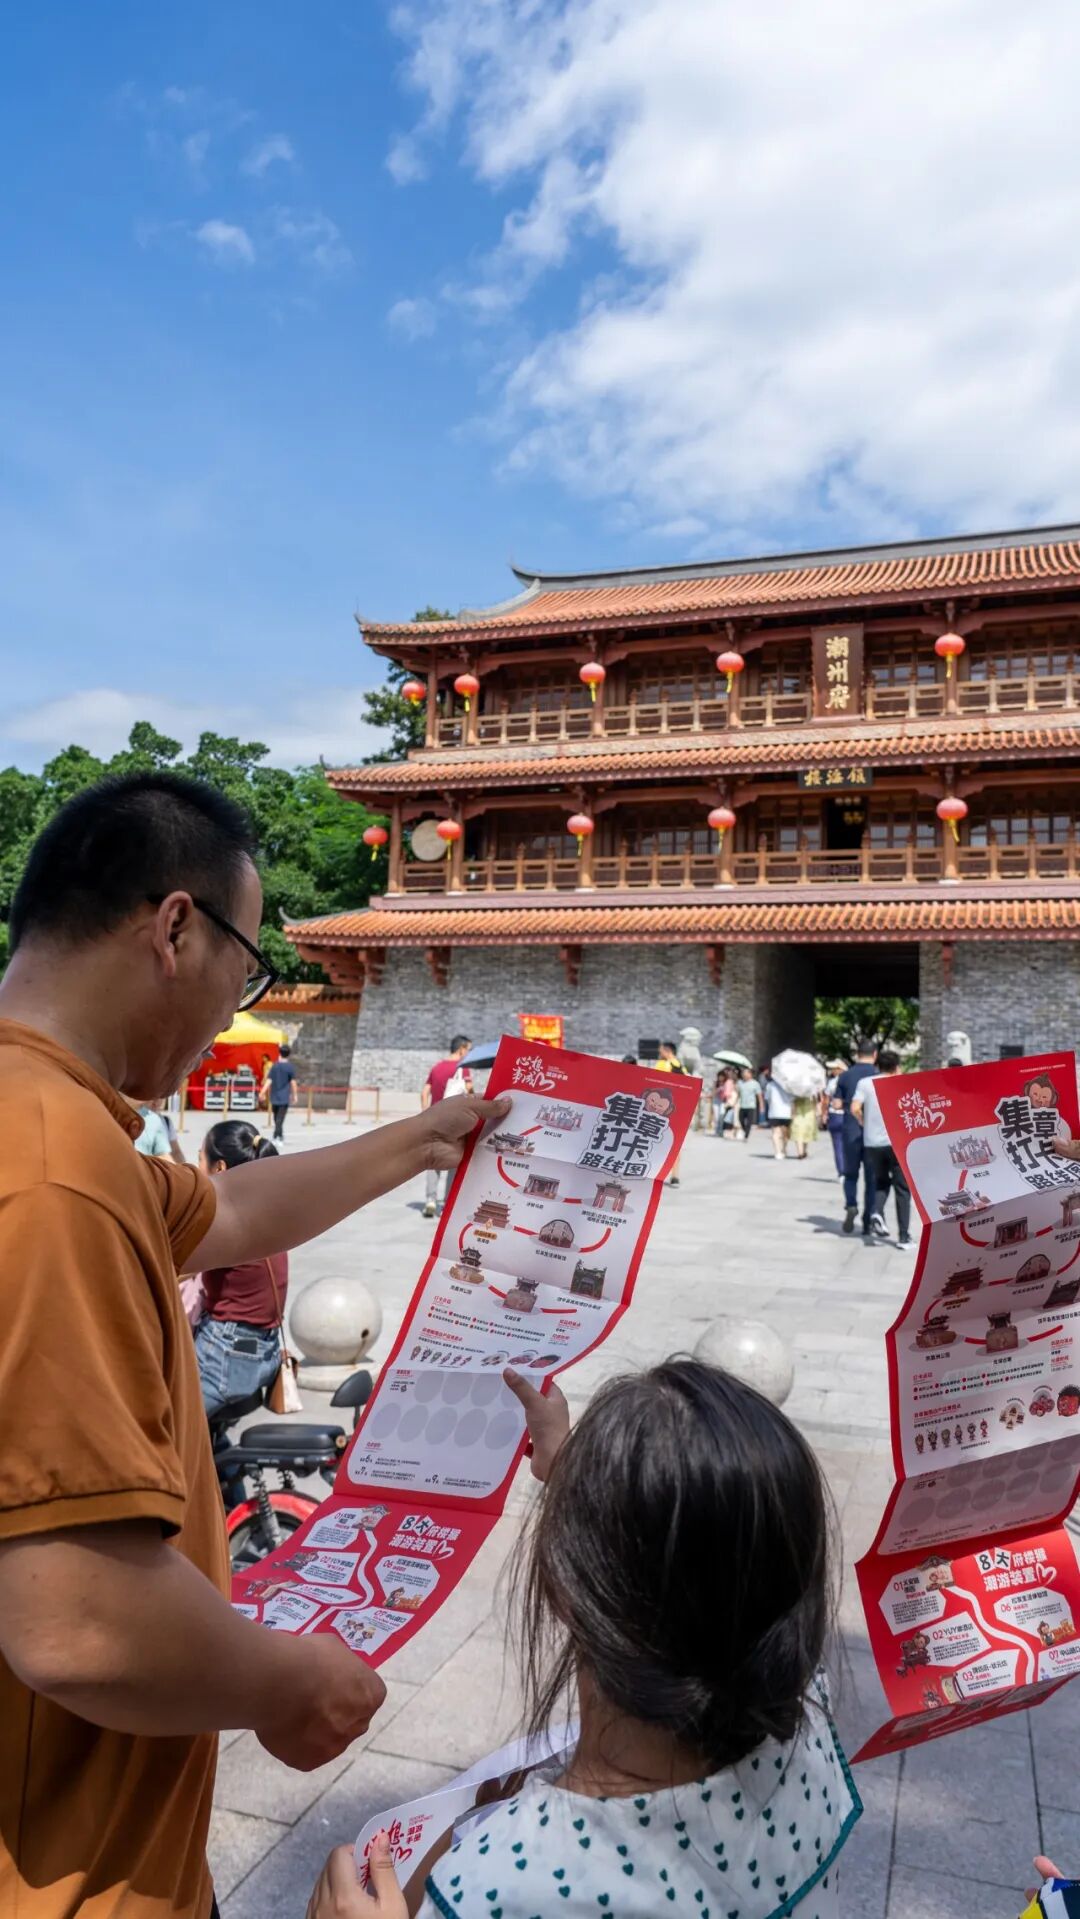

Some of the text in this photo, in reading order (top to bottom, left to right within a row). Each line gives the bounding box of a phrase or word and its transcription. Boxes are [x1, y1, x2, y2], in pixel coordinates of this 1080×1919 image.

[825, 636, 850, 710] 潮州府
[601, 1094, 668, 1141] 集章
[998, 1099, 1057, 1140] 集章
[590, 1123, 649, 1162] 打卡
[1006, 1137, 1063, 1174] 打卡
[579, 1152, 647, 1177] 路线图
[932, 1629, 944, 1640] 02
[962, 1671, 973, 1682] 03
